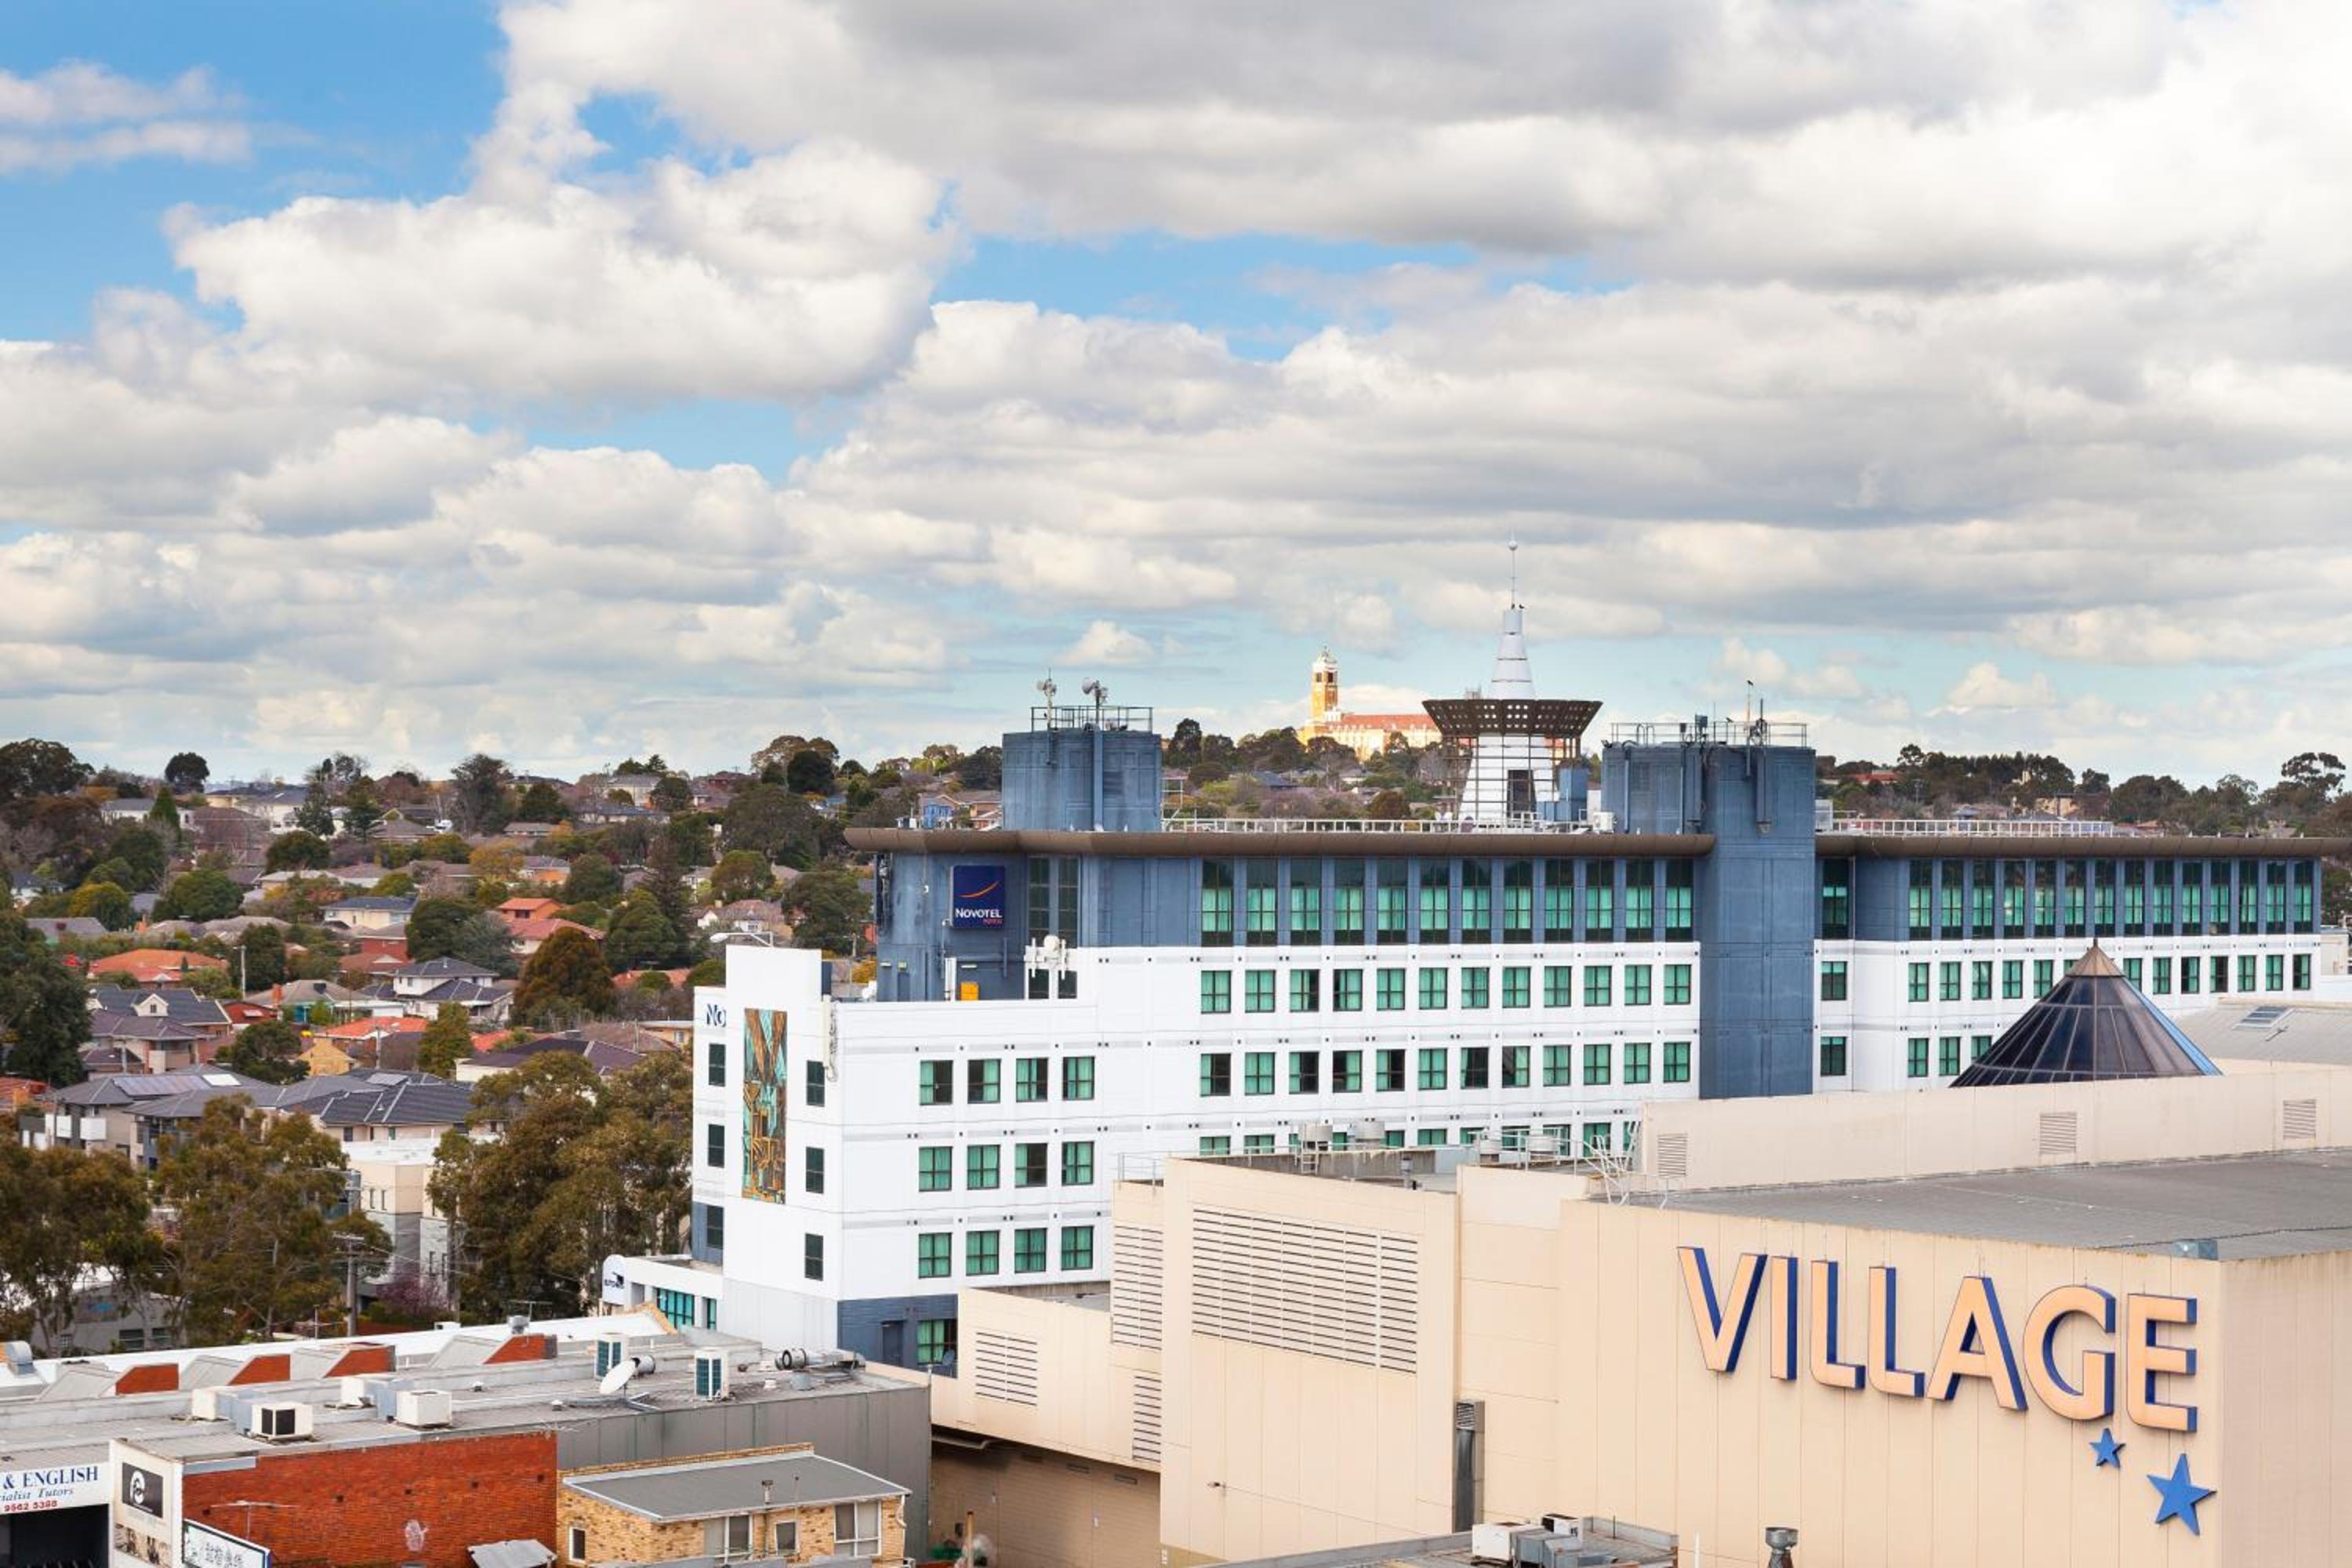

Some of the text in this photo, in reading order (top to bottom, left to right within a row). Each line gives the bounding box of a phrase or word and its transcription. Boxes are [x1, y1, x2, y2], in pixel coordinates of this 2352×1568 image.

[956, 907, 1003, 918] NOVOTEL
[1677, 1245, 2198, 1432] VILLAGE
[3, 1465, 99, 1490] & ENGLISH
[0, 1488, 74, 1501] ialist Tutors
